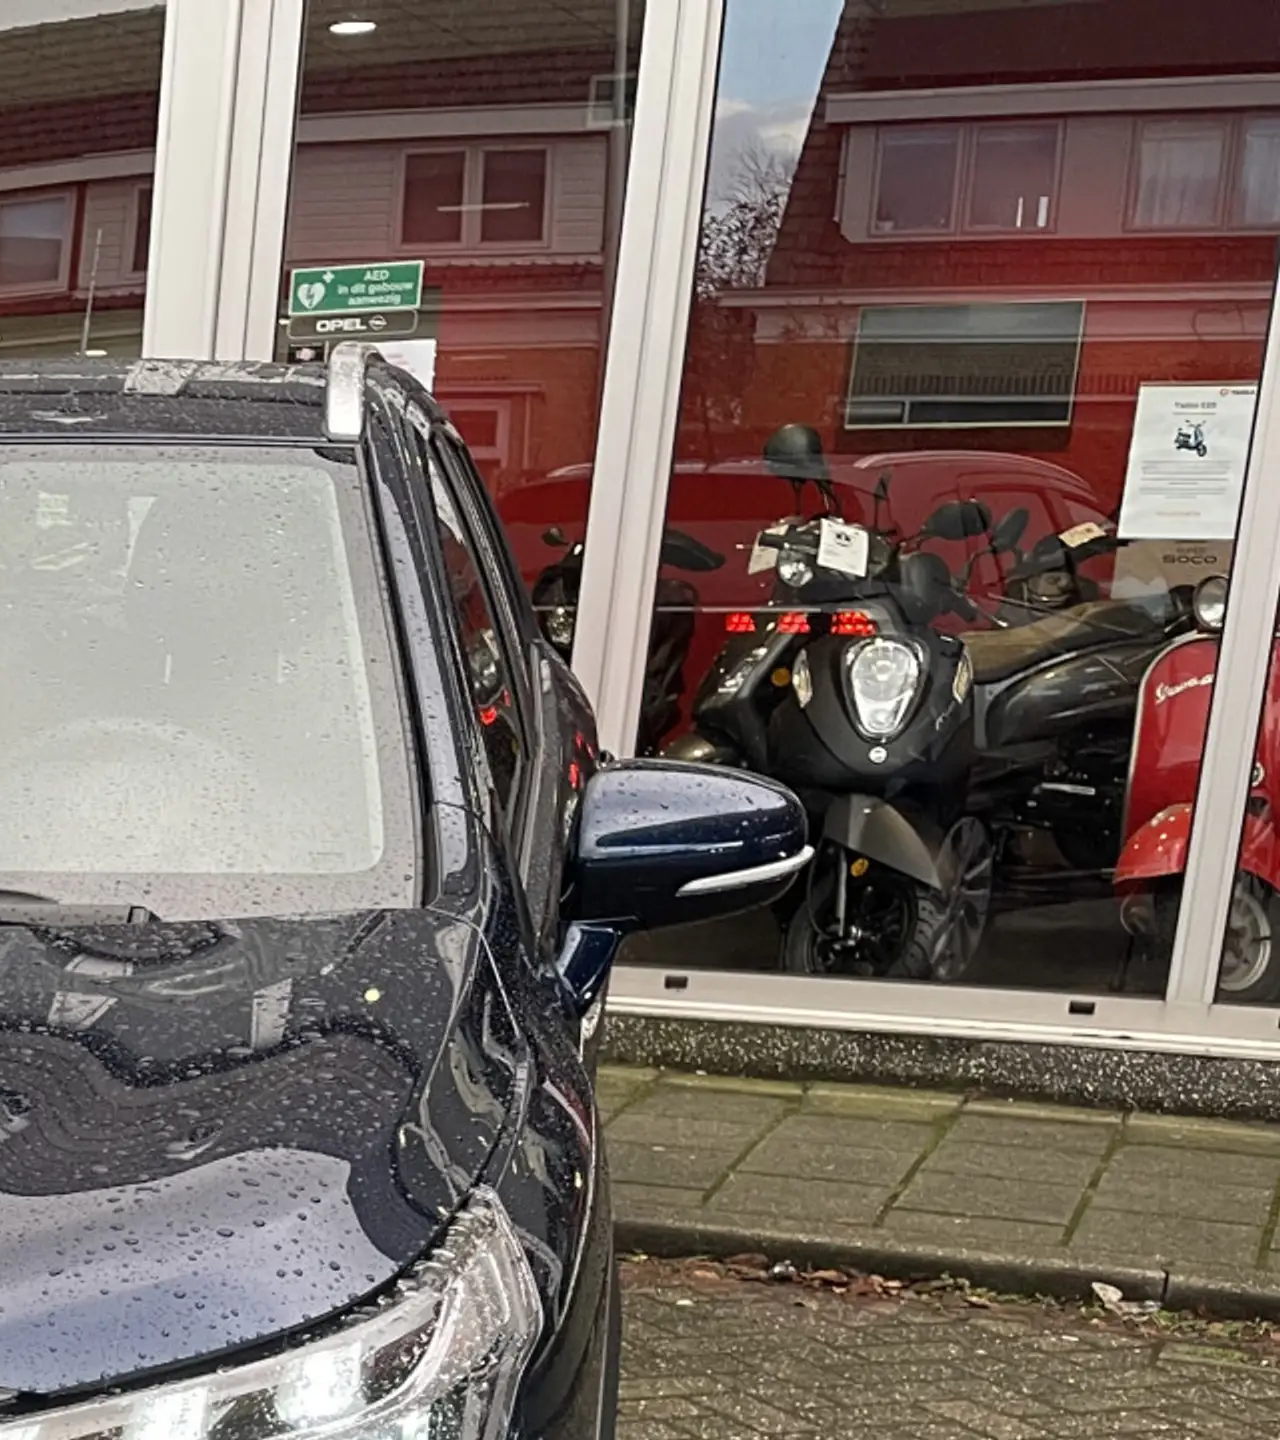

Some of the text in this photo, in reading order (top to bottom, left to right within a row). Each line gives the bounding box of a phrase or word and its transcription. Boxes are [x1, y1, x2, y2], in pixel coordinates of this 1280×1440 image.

[363, 270, 391, 281] AED
[316, 318, 367, 332] OPEL
[1162, 554, 1218, 565] SOCO
